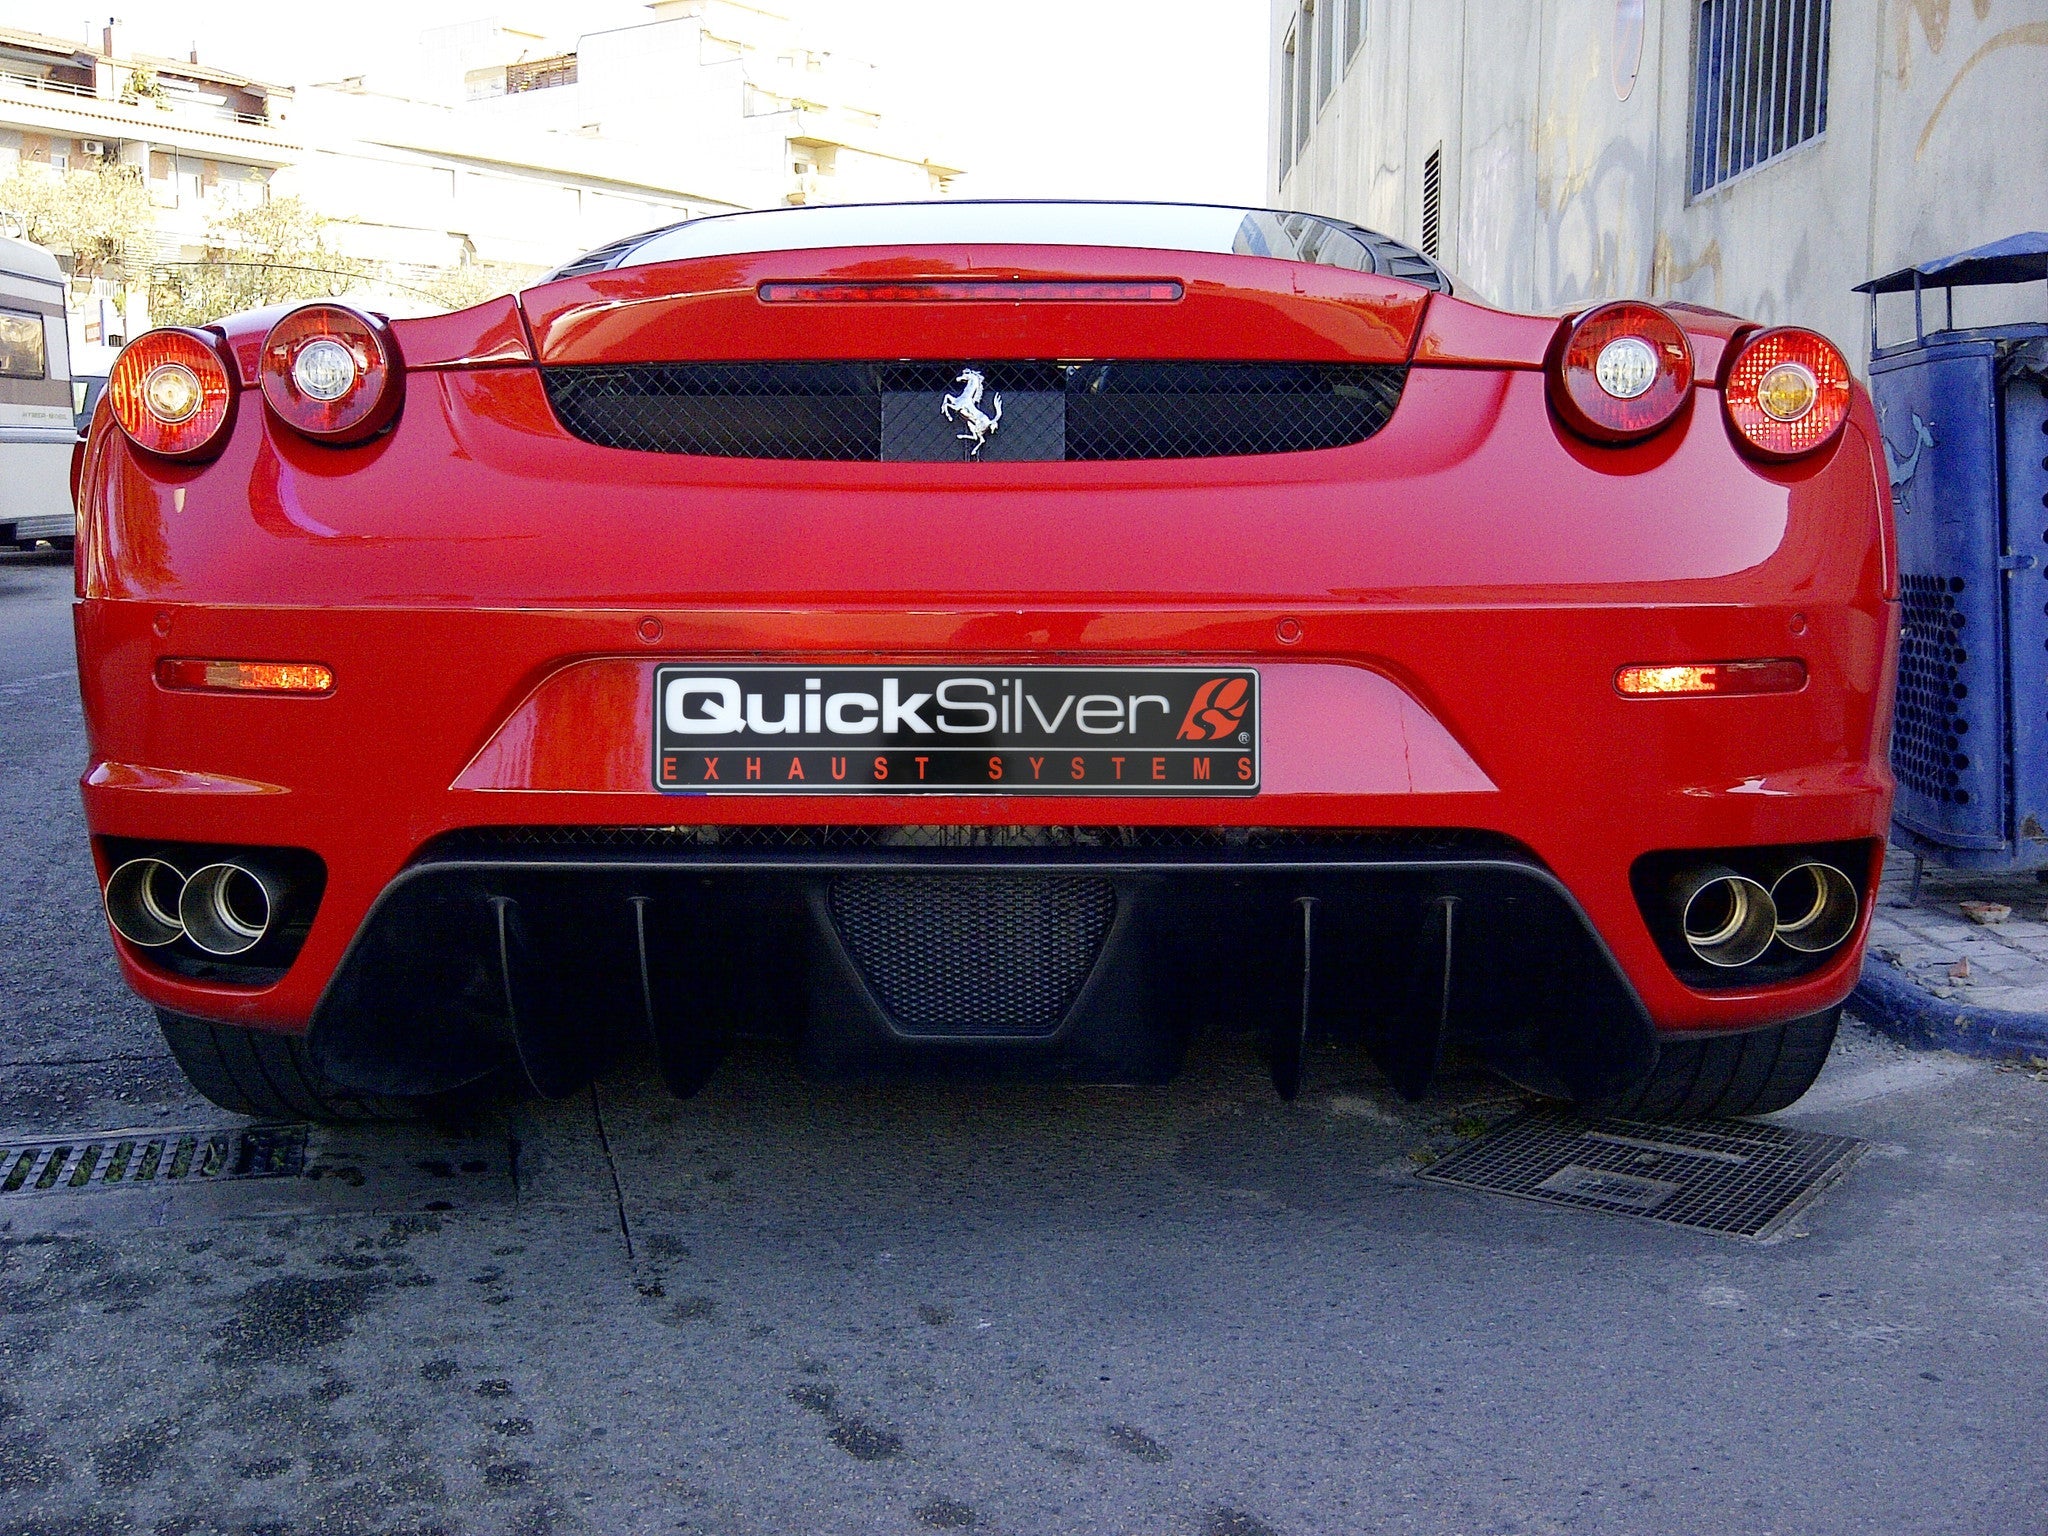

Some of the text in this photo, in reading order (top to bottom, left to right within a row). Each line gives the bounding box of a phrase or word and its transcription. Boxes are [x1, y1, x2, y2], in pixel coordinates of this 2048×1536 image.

[665, 677, 1171, 735] QuickSilver
[663, 757, 1252, 780] EXHAUST SYSTEMS
